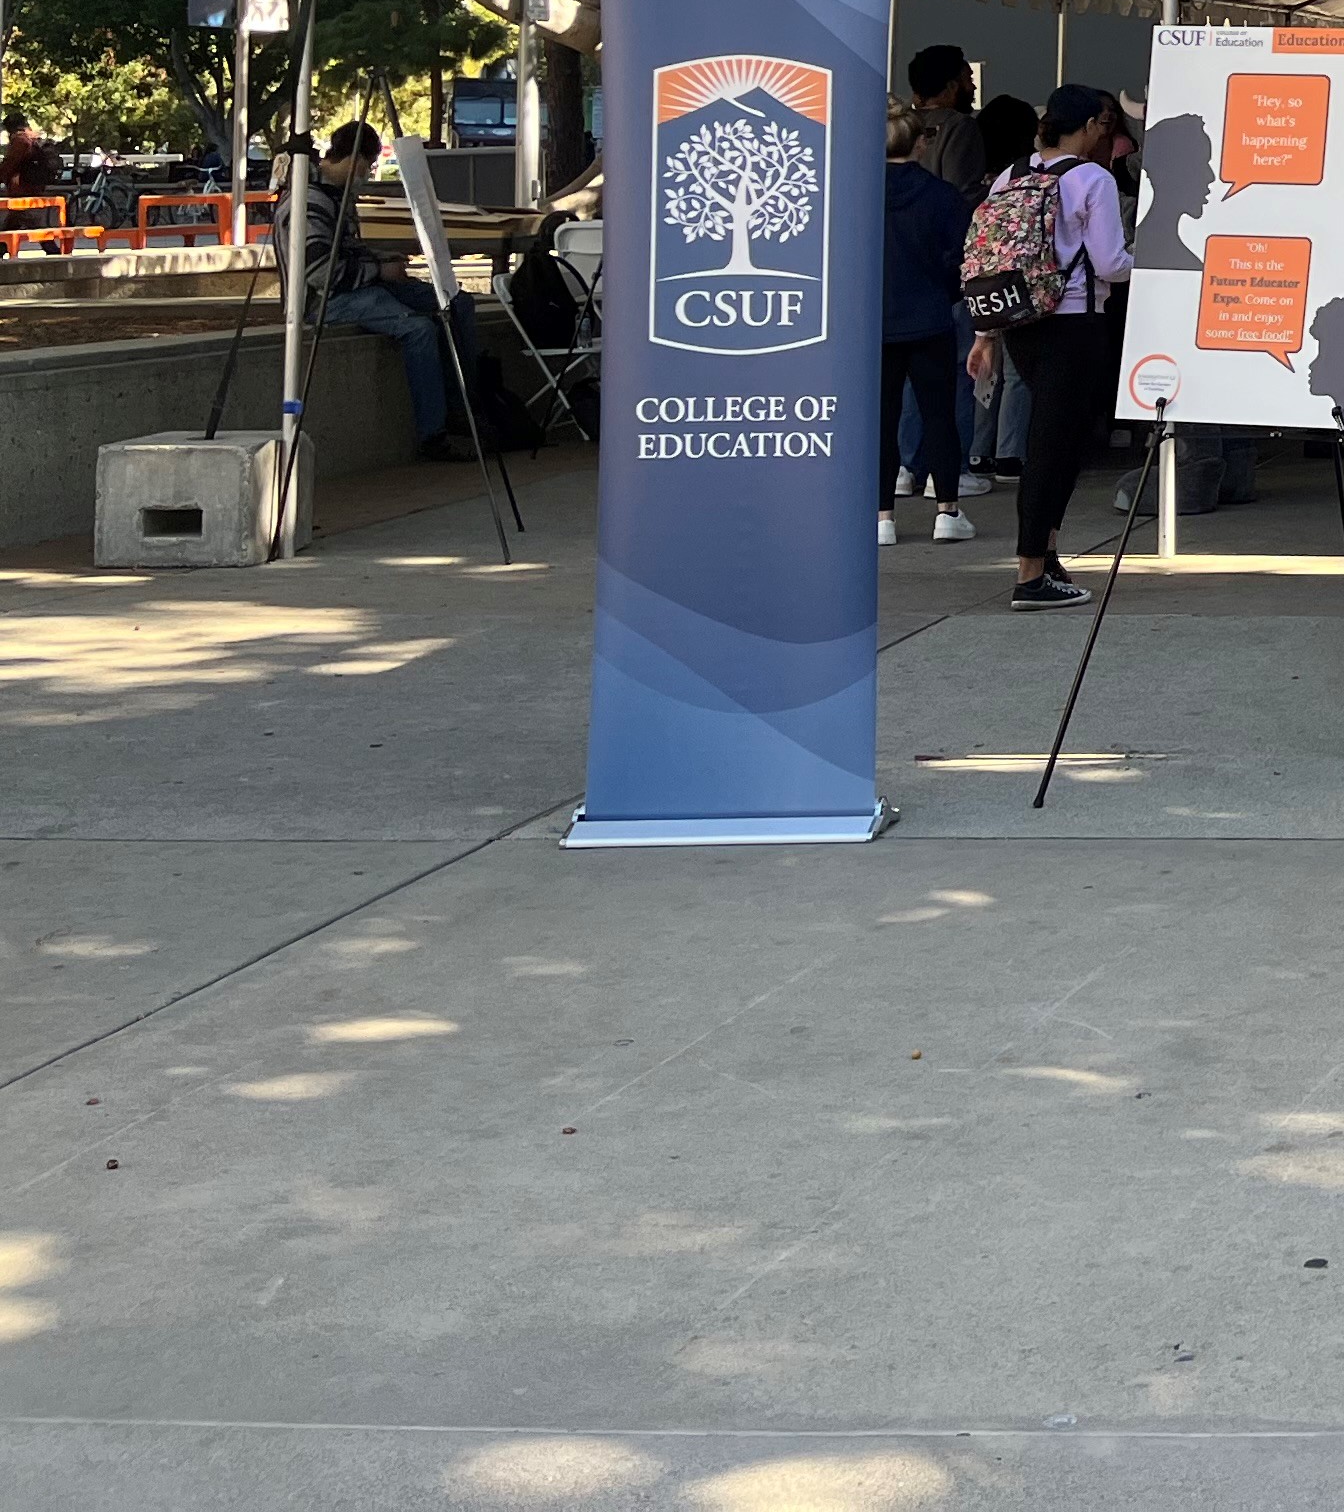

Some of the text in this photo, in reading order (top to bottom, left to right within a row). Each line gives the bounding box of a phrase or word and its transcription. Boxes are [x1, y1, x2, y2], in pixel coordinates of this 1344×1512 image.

[1158, 29, 1206, 46] CSUF
[1215, 37, 1264, 47] Education
[1288, 98, 1303, 108] so
[1256, 114, 1296, 127] what's
[1241, 133, 1308, 150] happening
[1229, 258, 1284, 271] This is the
[1210, 276, 1300, 289] Future Educator
[1245, 294, 1277, 305] Come
[1279, 297, 1294, 306] on
[674, 289, 804, 327] CSUF
[1218, 310, 1284, 326] in and enjoy
[1205, 329, 1234, 339] some
[1237, 328, 1260, 340] free
[635, 395, 838, 423] COLLEGE OF
[637, 431, 835, 460] EDUCATION
